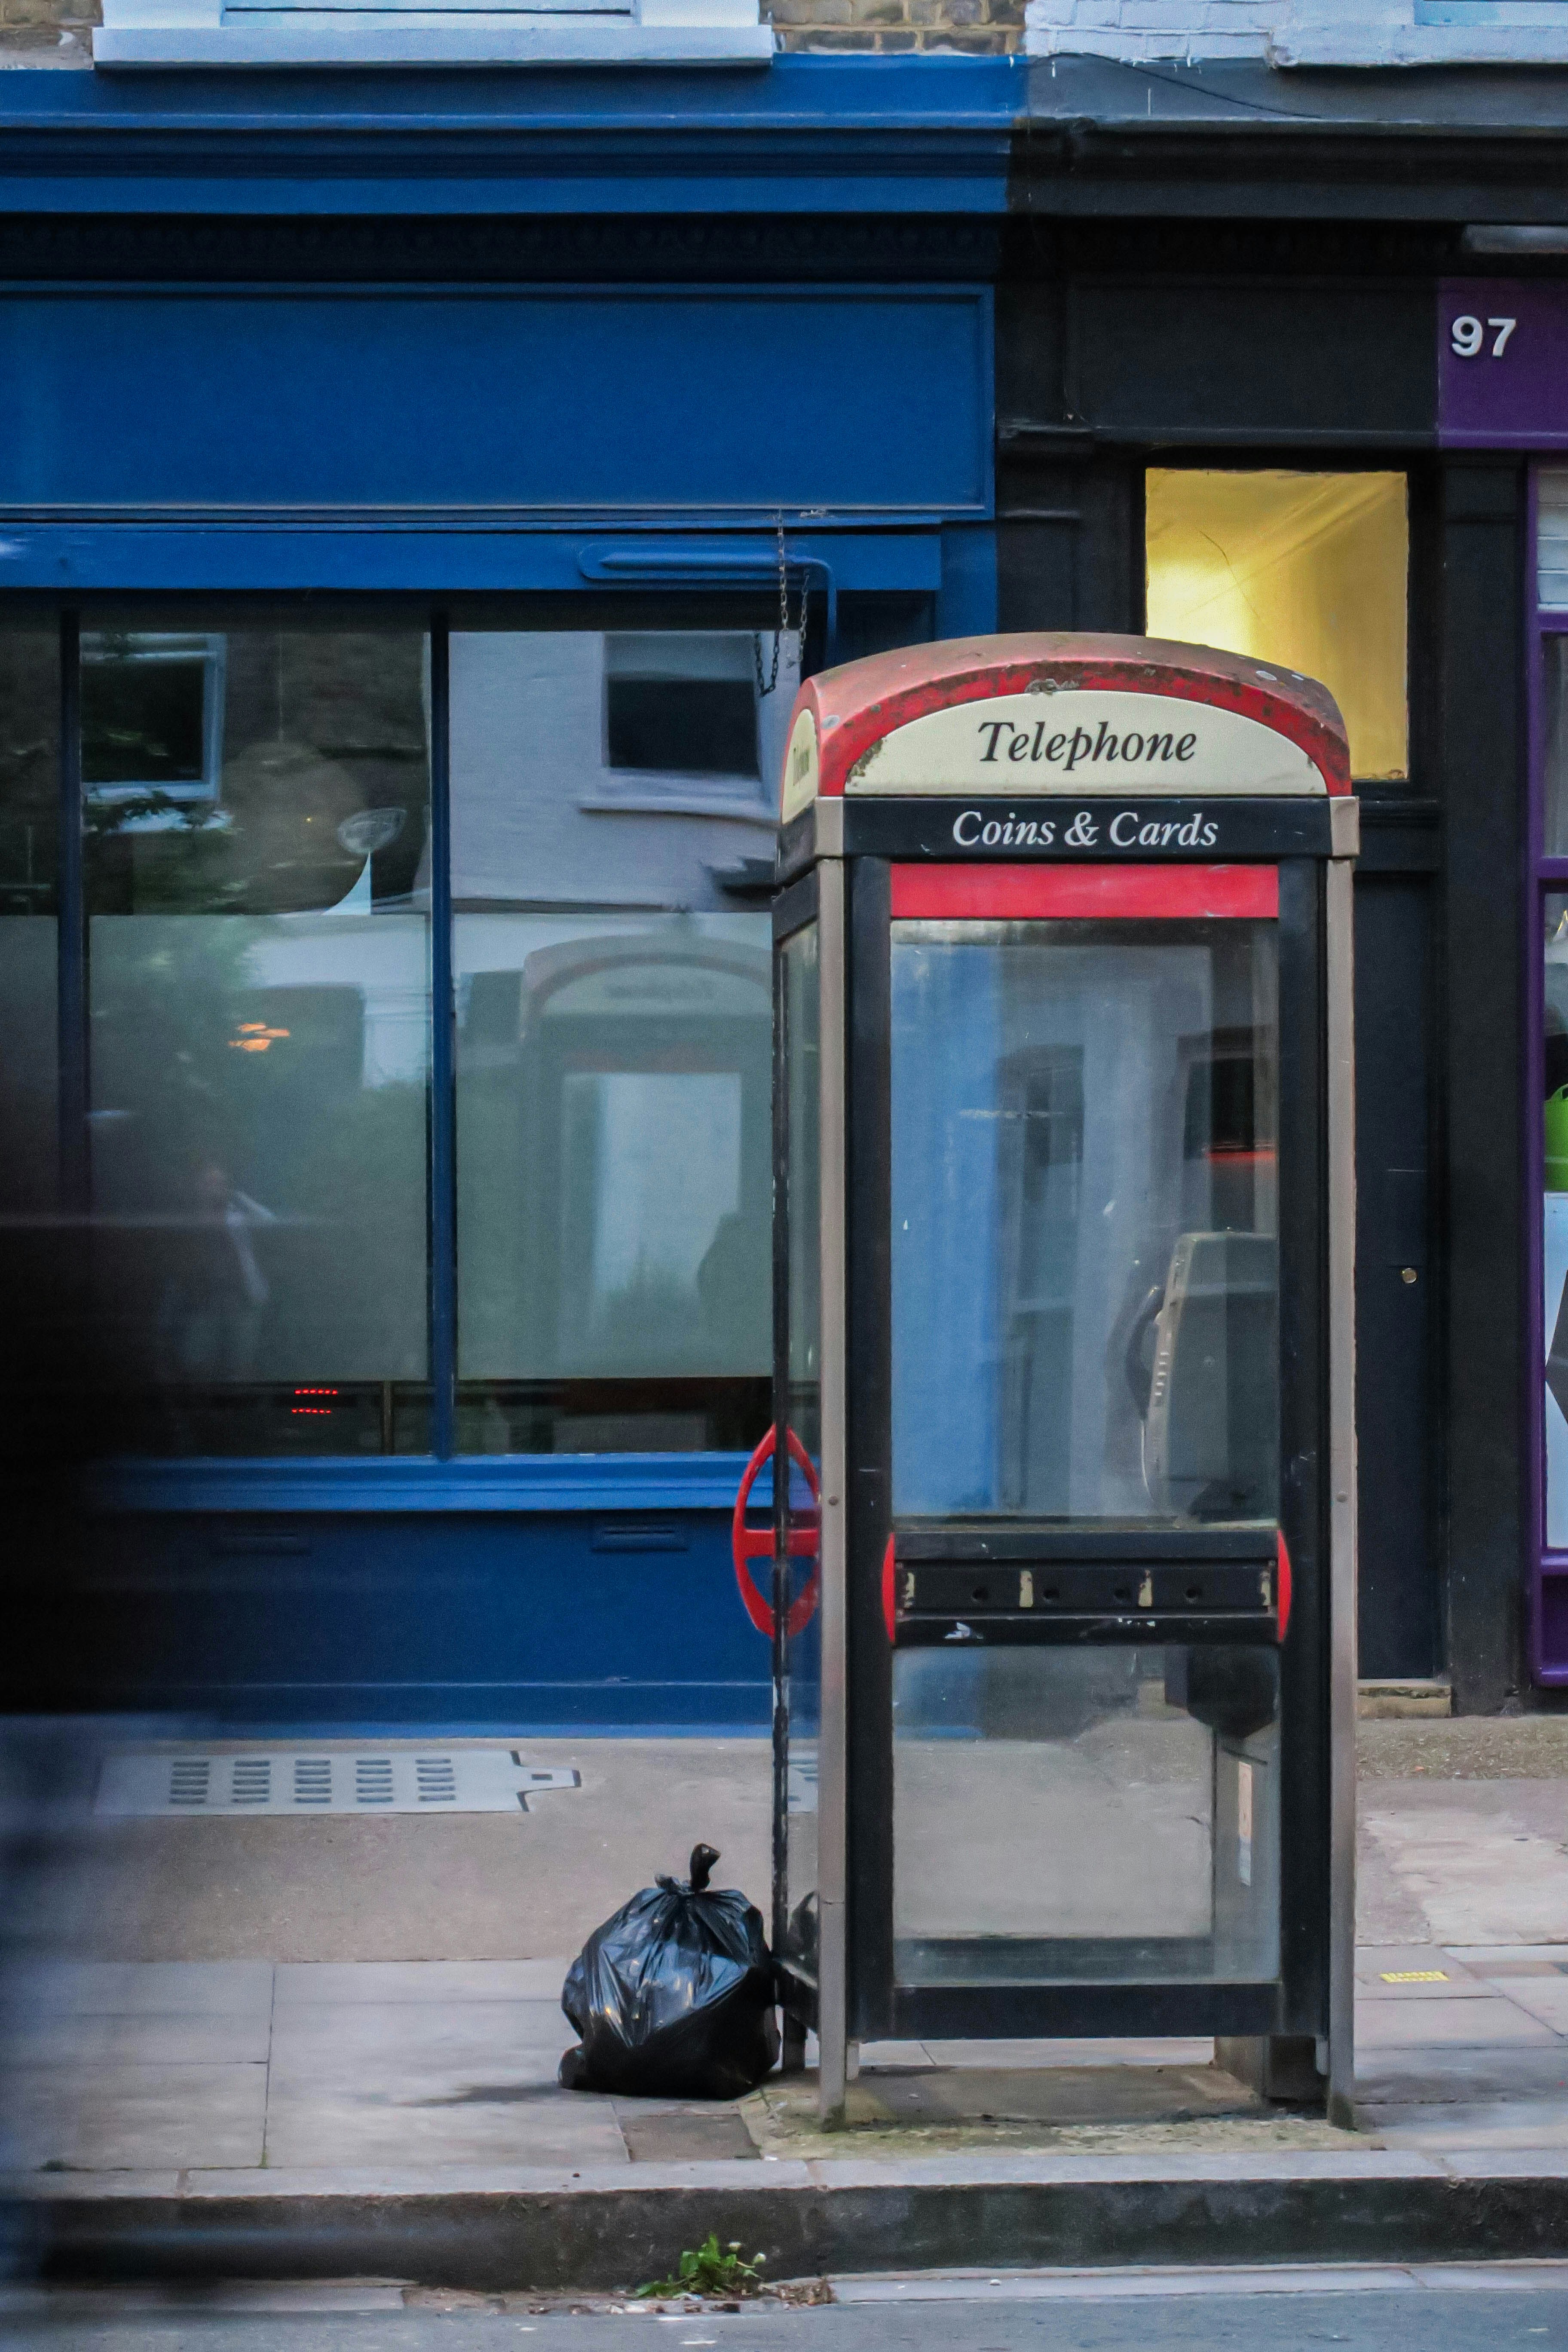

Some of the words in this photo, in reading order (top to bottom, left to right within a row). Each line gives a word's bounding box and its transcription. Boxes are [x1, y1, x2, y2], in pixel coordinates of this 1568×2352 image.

[1452, 316, 1517, 357] 97
[977, 721, 1197, 771] Telephone
[952, 810, 1057, 846] Coins
[1064, 812, 1100, 846] &
[1109, 812, 1219, 846] Cards
